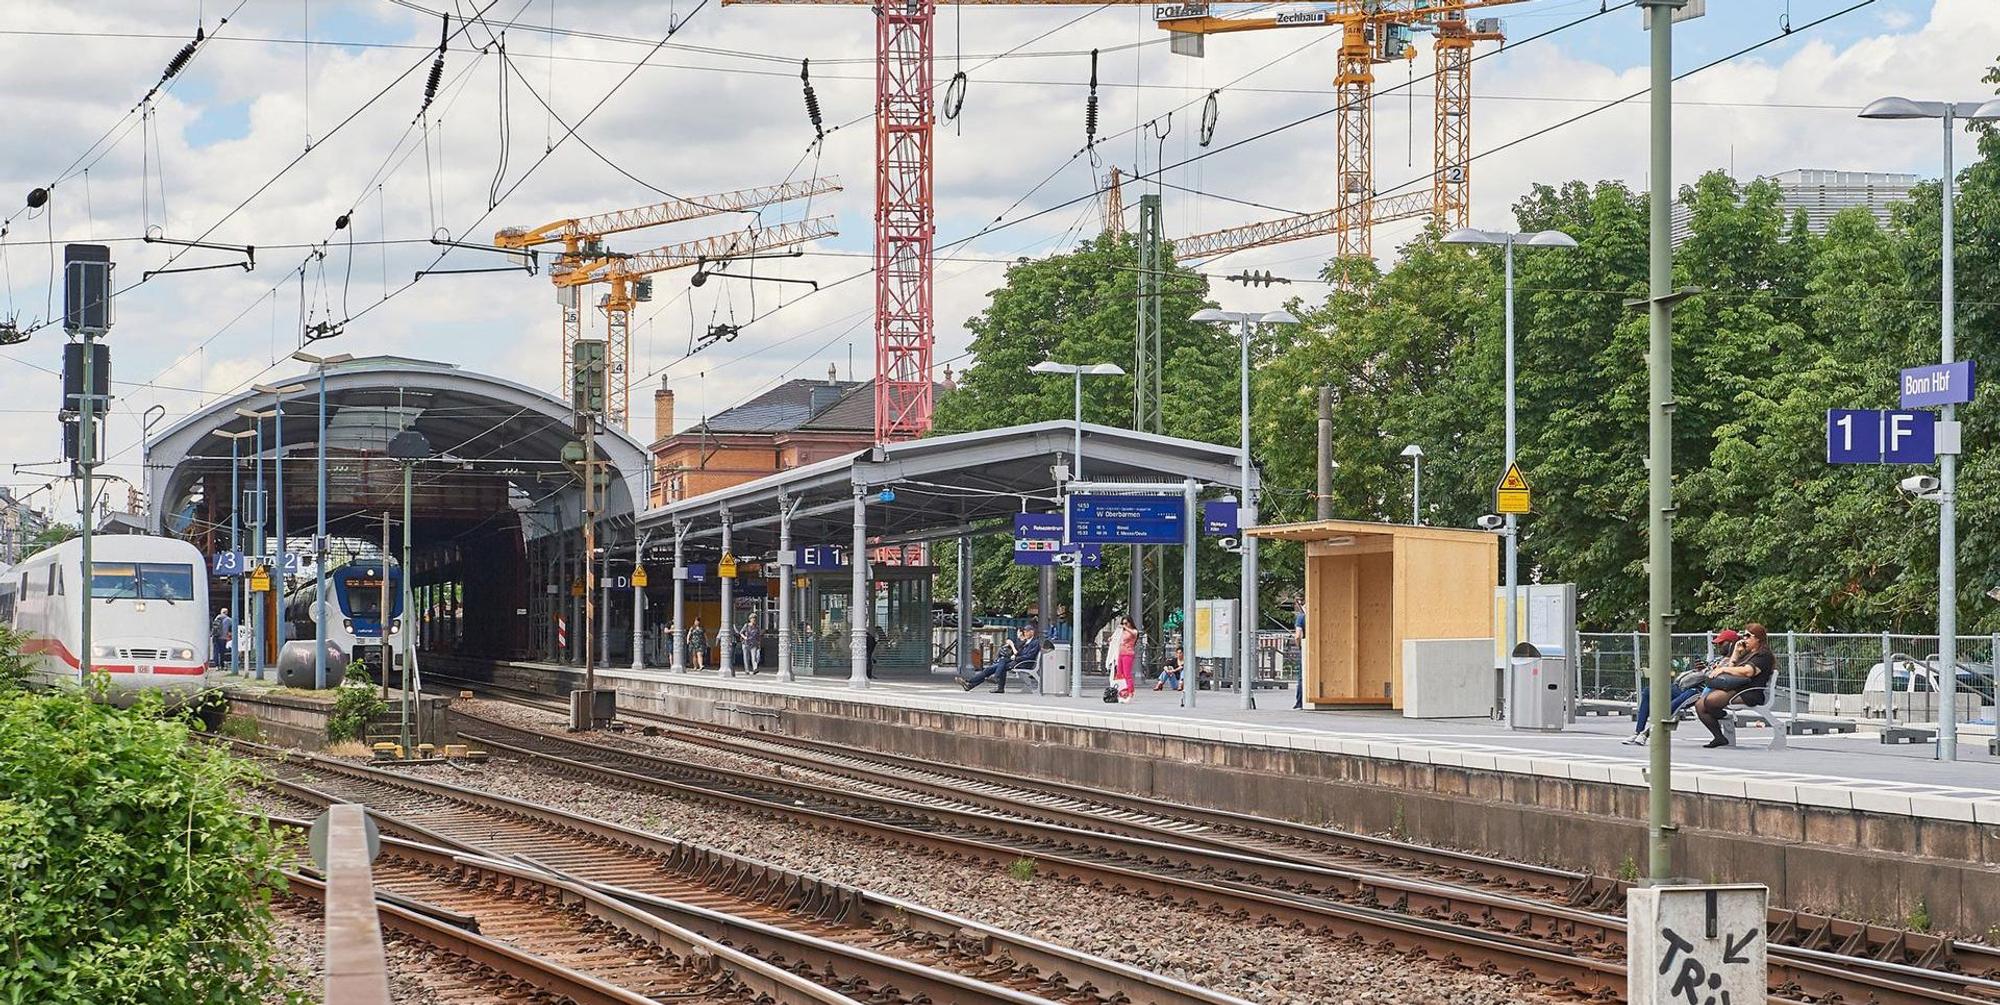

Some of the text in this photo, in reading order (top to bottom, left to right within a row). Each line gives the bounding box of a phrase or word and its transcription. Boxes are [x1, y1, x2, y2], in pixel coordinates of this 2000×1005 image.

[1277, 13, 1317, 23] Zechbau
[1452, 168, 1461, 180] 2
[570, 313, 577, 321] 5
[615, 363, 623, 372] 4
[1905, 370, 1950, 395] Bonn Hbf
[1837, 414, 1914, 452] 1 F
[1105, 510, 1141, 518] Oberbarmen
[224, 551, 236, 569] 3
[285, 553, 295, 569] 2
[804, 548, 840, 565] E 1
[617, 575, 627, 588] D
